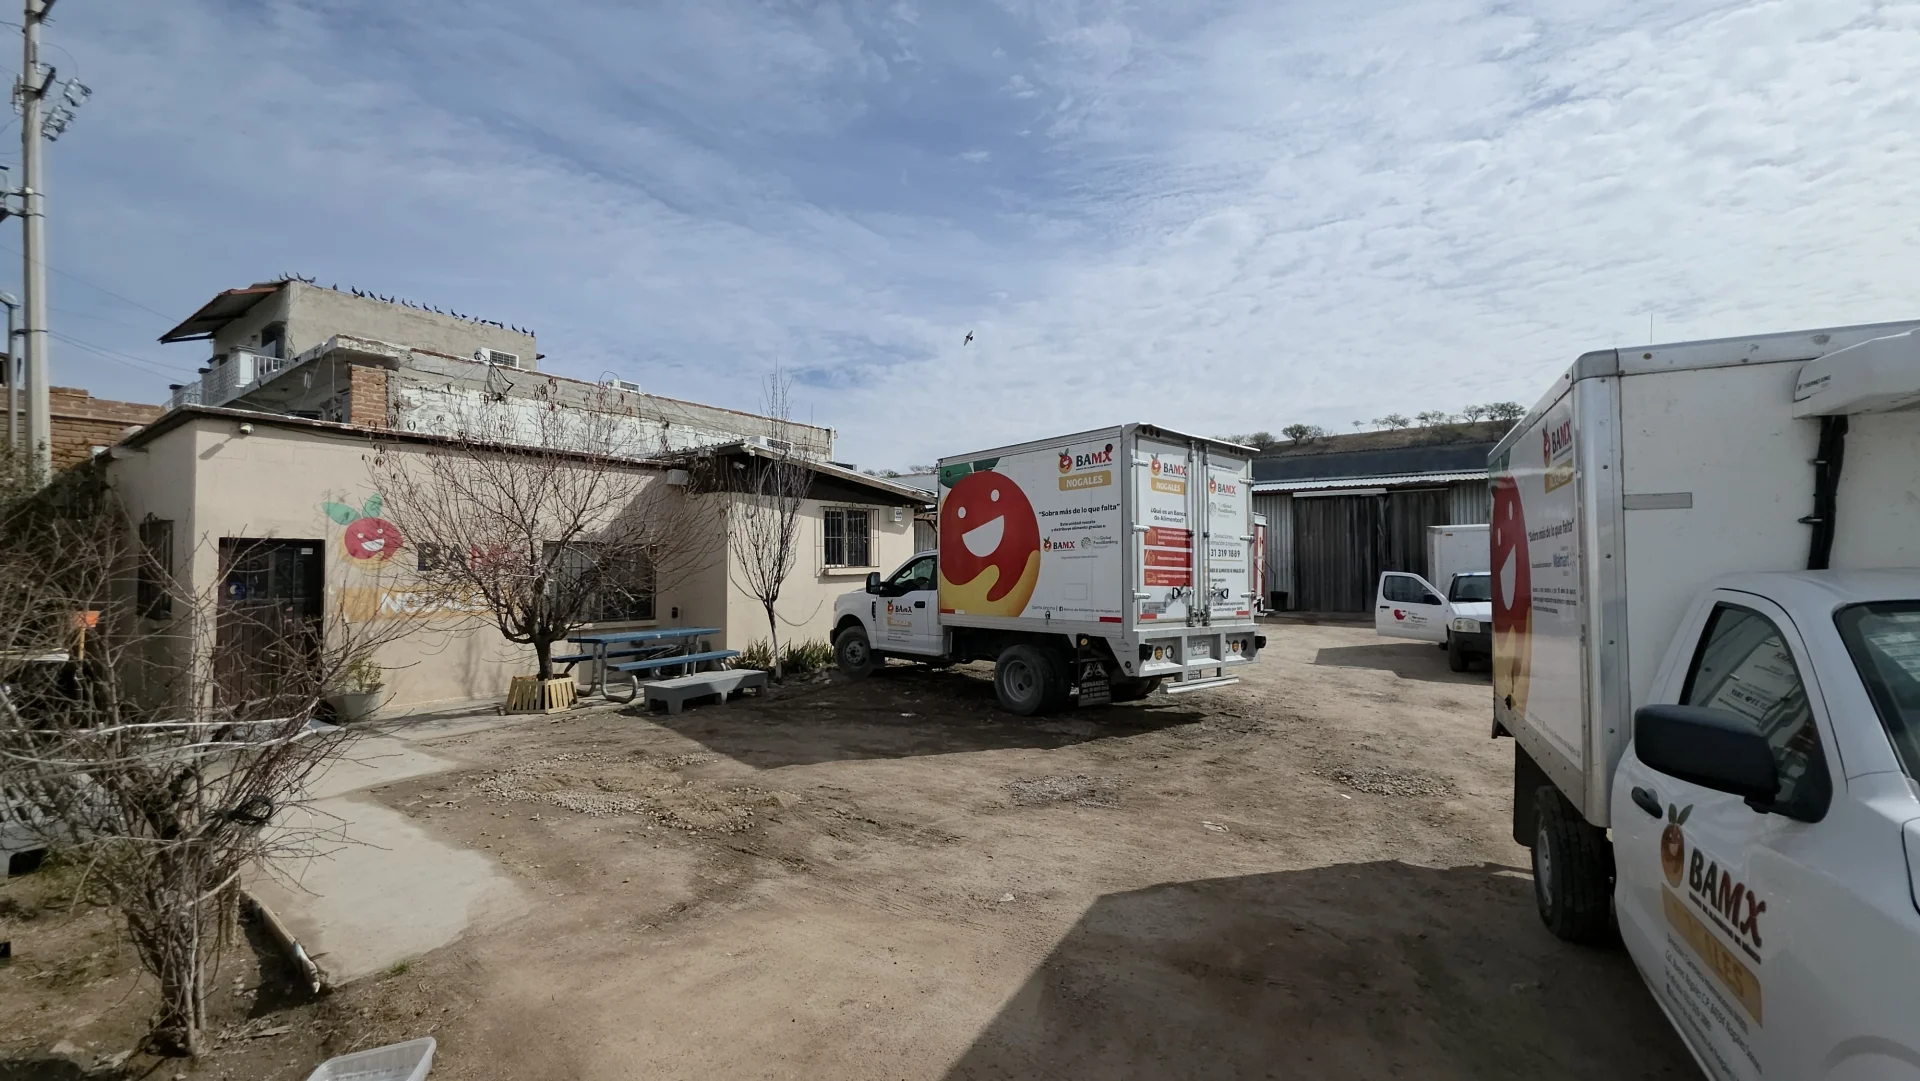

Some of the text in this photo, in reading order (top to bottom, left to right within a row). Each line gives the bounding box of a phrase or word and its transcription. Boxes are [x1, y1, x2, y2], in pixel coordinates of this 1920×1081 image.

[1552, 420, 1572, 454] BAMX
[1076, 451, 1112, 467] BAMX
[1163, 463, 1187, 476] BAMX
[1066, 475, 1103, 488] NOGALES
[1156, 482, 1181, 492] NOGALES
[1218, 484, 1236, 495] BAMX
[1089, 506, 1100, 514] que
[1053, 541, 1076, 550] BAMX
[1218, 549, 1227, 557] 319
[1553, 552, 1569, 567] Walmart
[1689, 847, 1766, 949] BAMX
